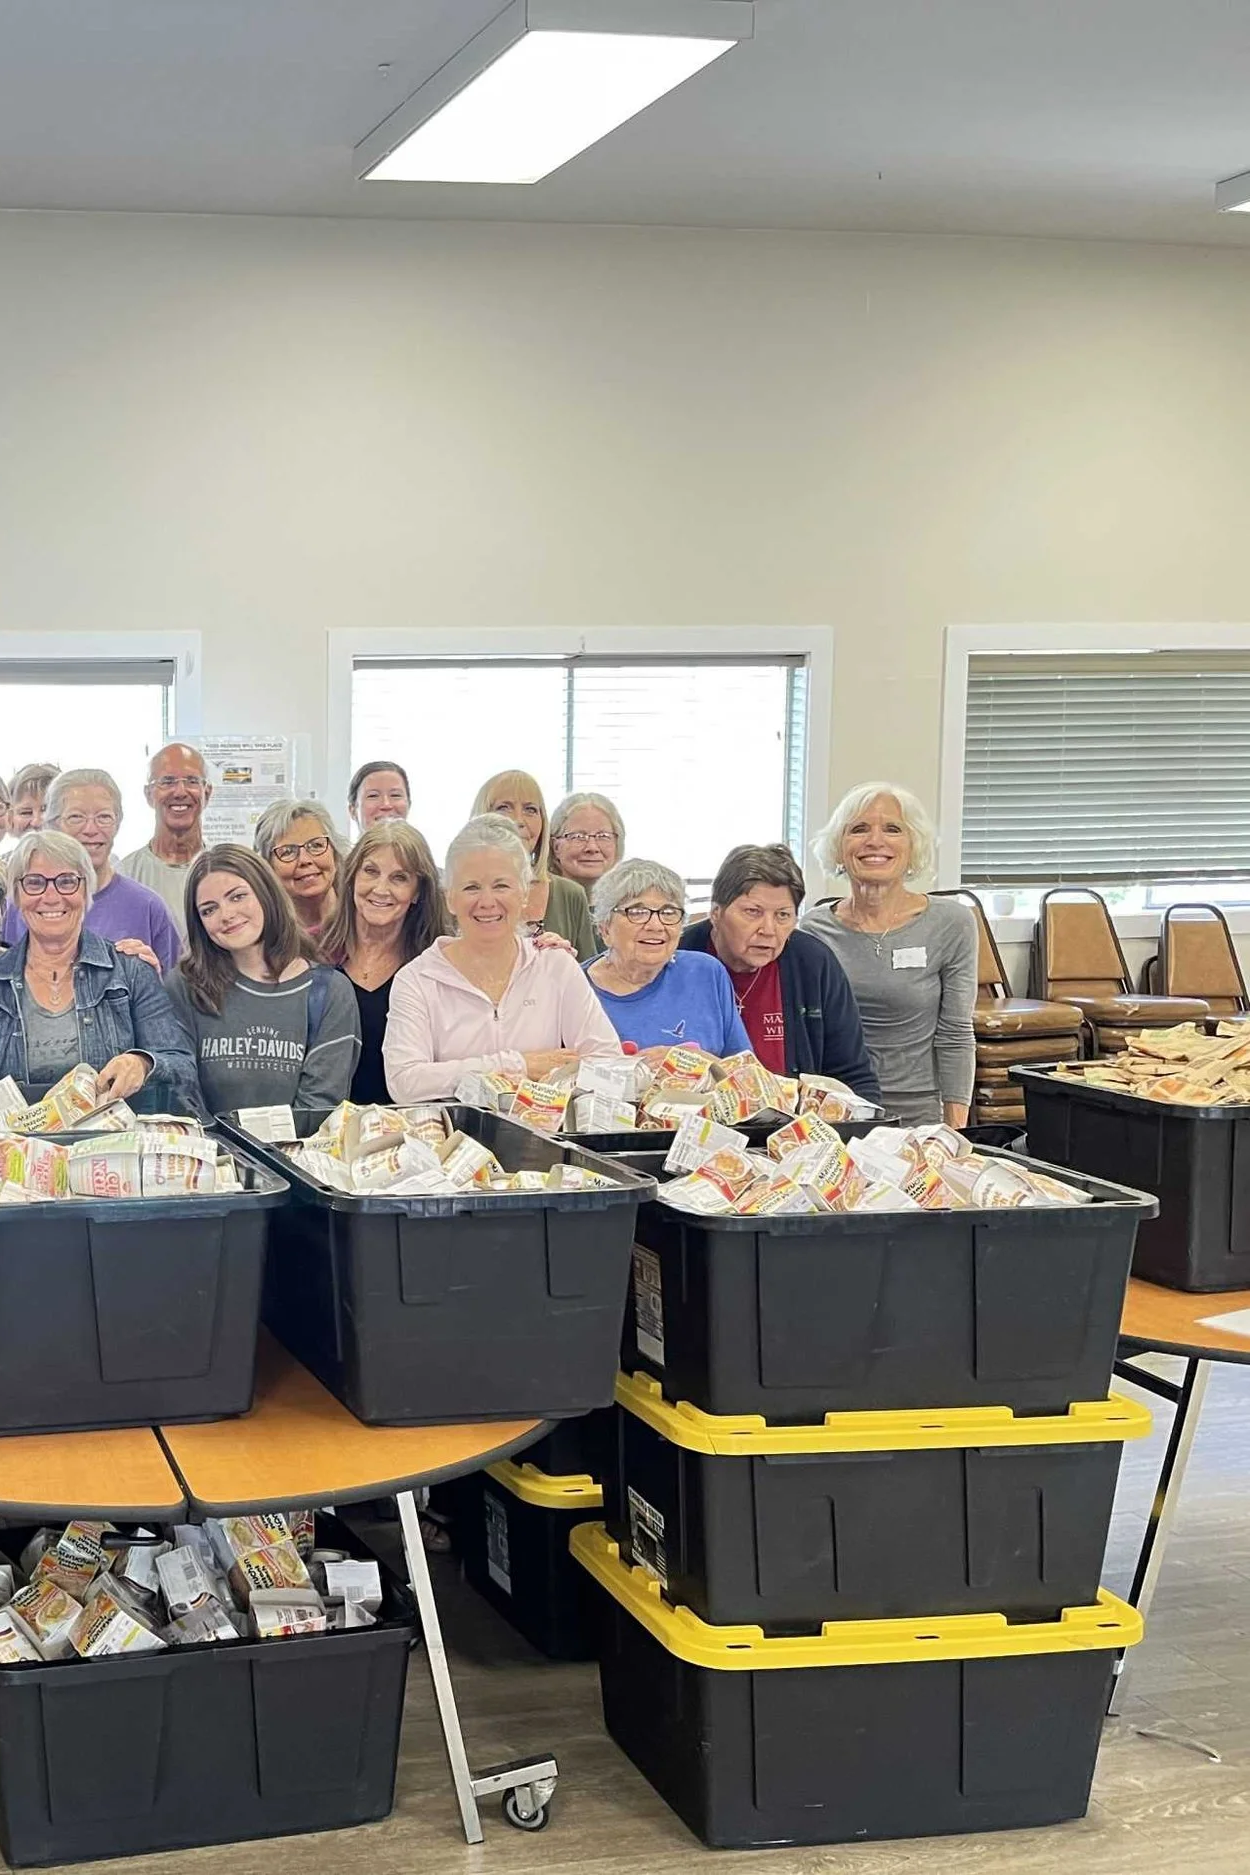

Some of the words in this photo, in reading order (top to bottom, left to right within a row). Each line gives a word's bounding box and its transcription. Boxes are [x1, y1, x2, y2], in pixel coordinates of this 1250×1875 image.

[18, 1104, 53, 1122] Maruchan
[816, 1120, 837, 1141] Maruc
[106, 1172, 119, 1196] CU
[244, 1558, 262, 1589] aruchan
[255, 1565, 270, 1589] nstant
